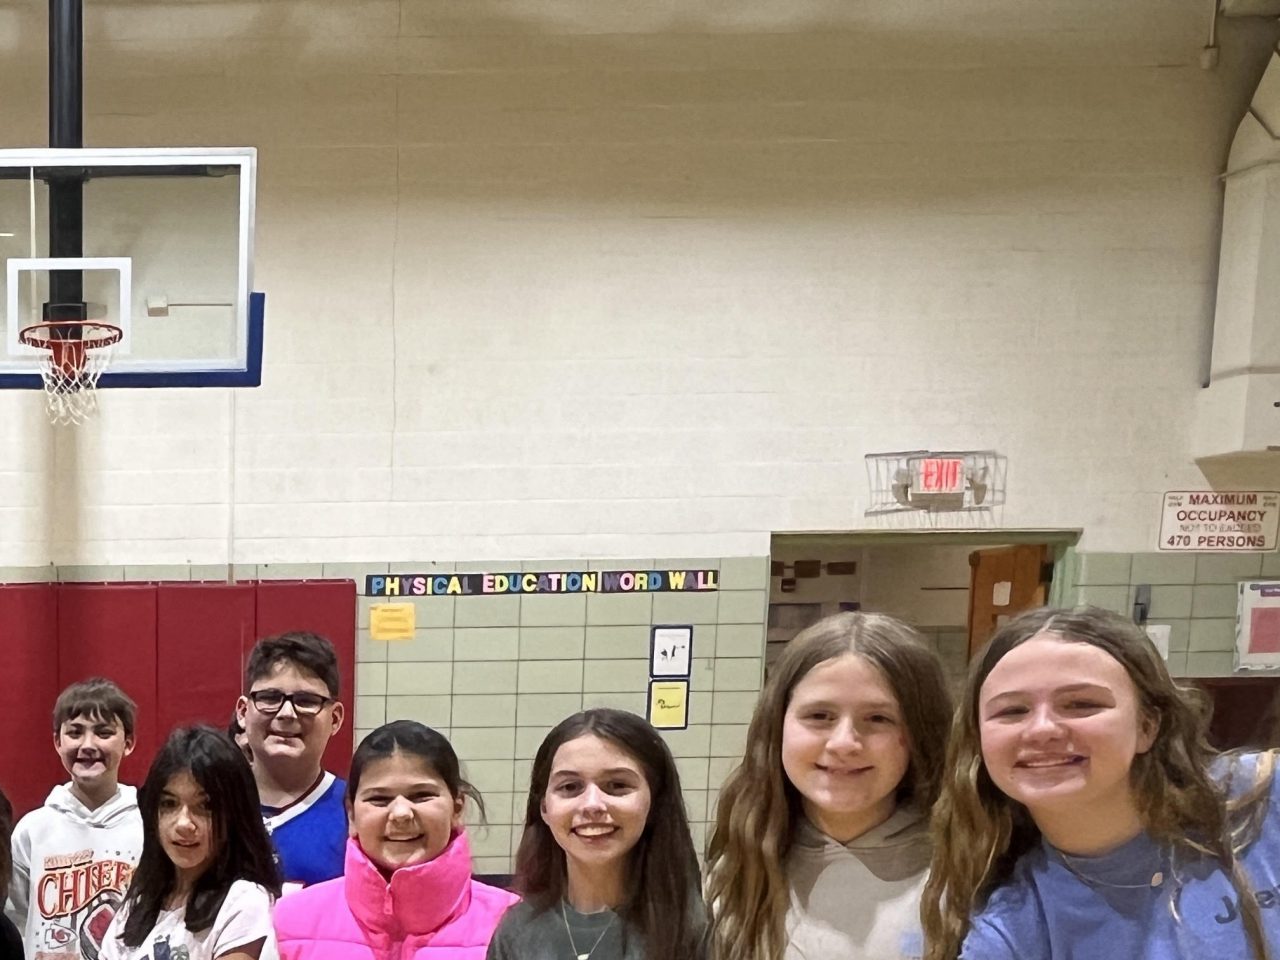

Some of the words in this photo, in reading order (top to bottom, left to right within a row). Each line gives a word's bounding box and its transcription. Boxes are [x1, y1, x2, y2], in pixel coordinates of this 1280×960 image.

[924, 460, 961, 489] EXIT
[1188, 494, 1258, 505] MAXIMUM
[1176, 510, 1267, 521] OCCUPANCY
[1197, 535, 1266, 547] PERSONS
[371, 575, 472, 595] PHYSICAL
[483, 573, 598, 593] EDUCATION
[603, 572, 662, 592] WORD
[669, 570, 718, 590] WALL
[37, 859, 134, 920] CHIEF
